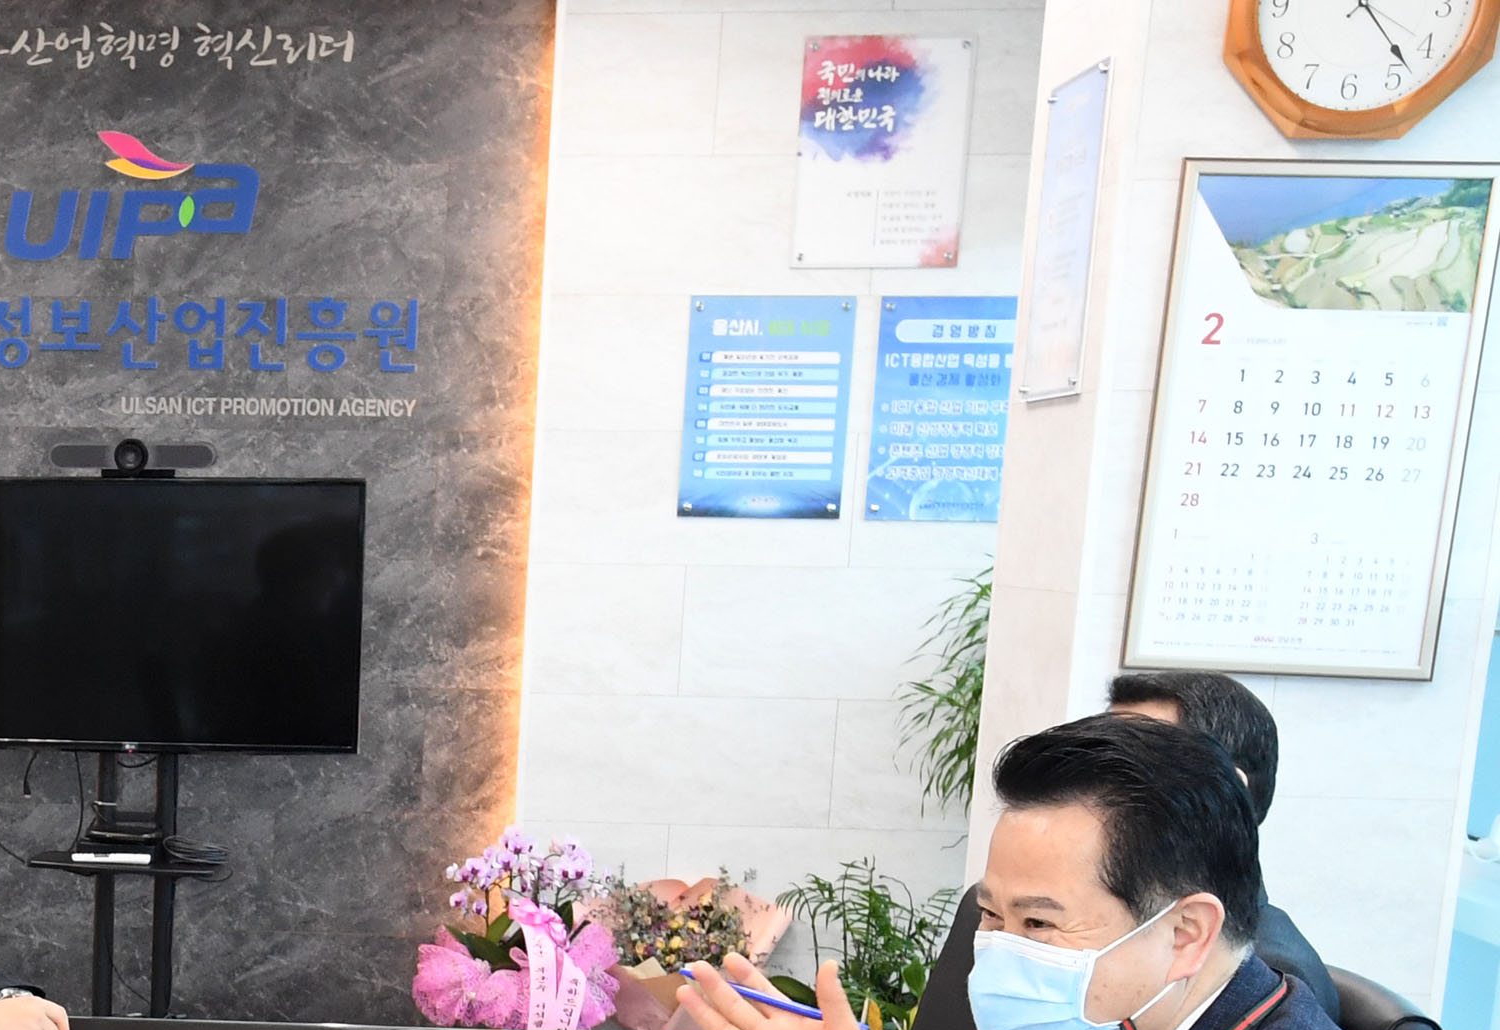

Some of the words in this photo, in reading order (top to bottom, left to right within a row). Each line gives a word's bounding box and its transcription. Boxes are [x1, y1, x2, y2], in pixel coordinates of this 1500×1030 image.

[196, 25, 356, 69] 혁신리더
[1277, 31, 1295, 59] 8
[1417, 32, 1435, 59] 4
[1303, 63, 1319, 90] 7
[1340, 73, 1358, 100] 6
[1384, 63, 1403, 91] 5
[814, 106, 897, 132] 대한민국
[1202, 313, 1223, 344] 2
[1241, 369, 1244, 382] 1
[1275, 370, 1283, 383] 2
[1311, 371, 1320, 384] 3
[1348, 372, 1356, 384] 4
[1385, 373, 1393, 386] 5
[120, 397, 183, 414] ULSAN
[187, 398, 217, 415] ICT
[220, 398, 334, 417] PROMOTION
[338, 399, 417, 418] AGENCY
[1199, 400, 1206, 412] 7
[1234, 401, 1243, 414] 8
[1271, 401, 1279, 414] 9
[1305, 403, 1321, 416] 10
[1341, 404, 1355, 416] 11
[1378, 405, 1394, 418] 12
[1414, 405, 1430, 419] 13
[1192, 431, 1206, 444] 14
[1228, 432, 1243, 445] 15
[1264, 433, 1279, 446] 16
[1300, 434, 1316, 447] 17
[1337, 435, 1353, 448] 18
[1373, 436, 1389, 449] 19
[1184, 462, 1201, 475] 21
[1221, 463, 1239, 477] 22
[1257, 464, 1275, 478] 23
[1293, 466, 1311, 478] 24
[1329, 467, 1348, 480] 25
[1365, 468, 1384, 481] 26
[1181, 493, 1199, 506] 28
[1310, 532, 1319, 544] 3
